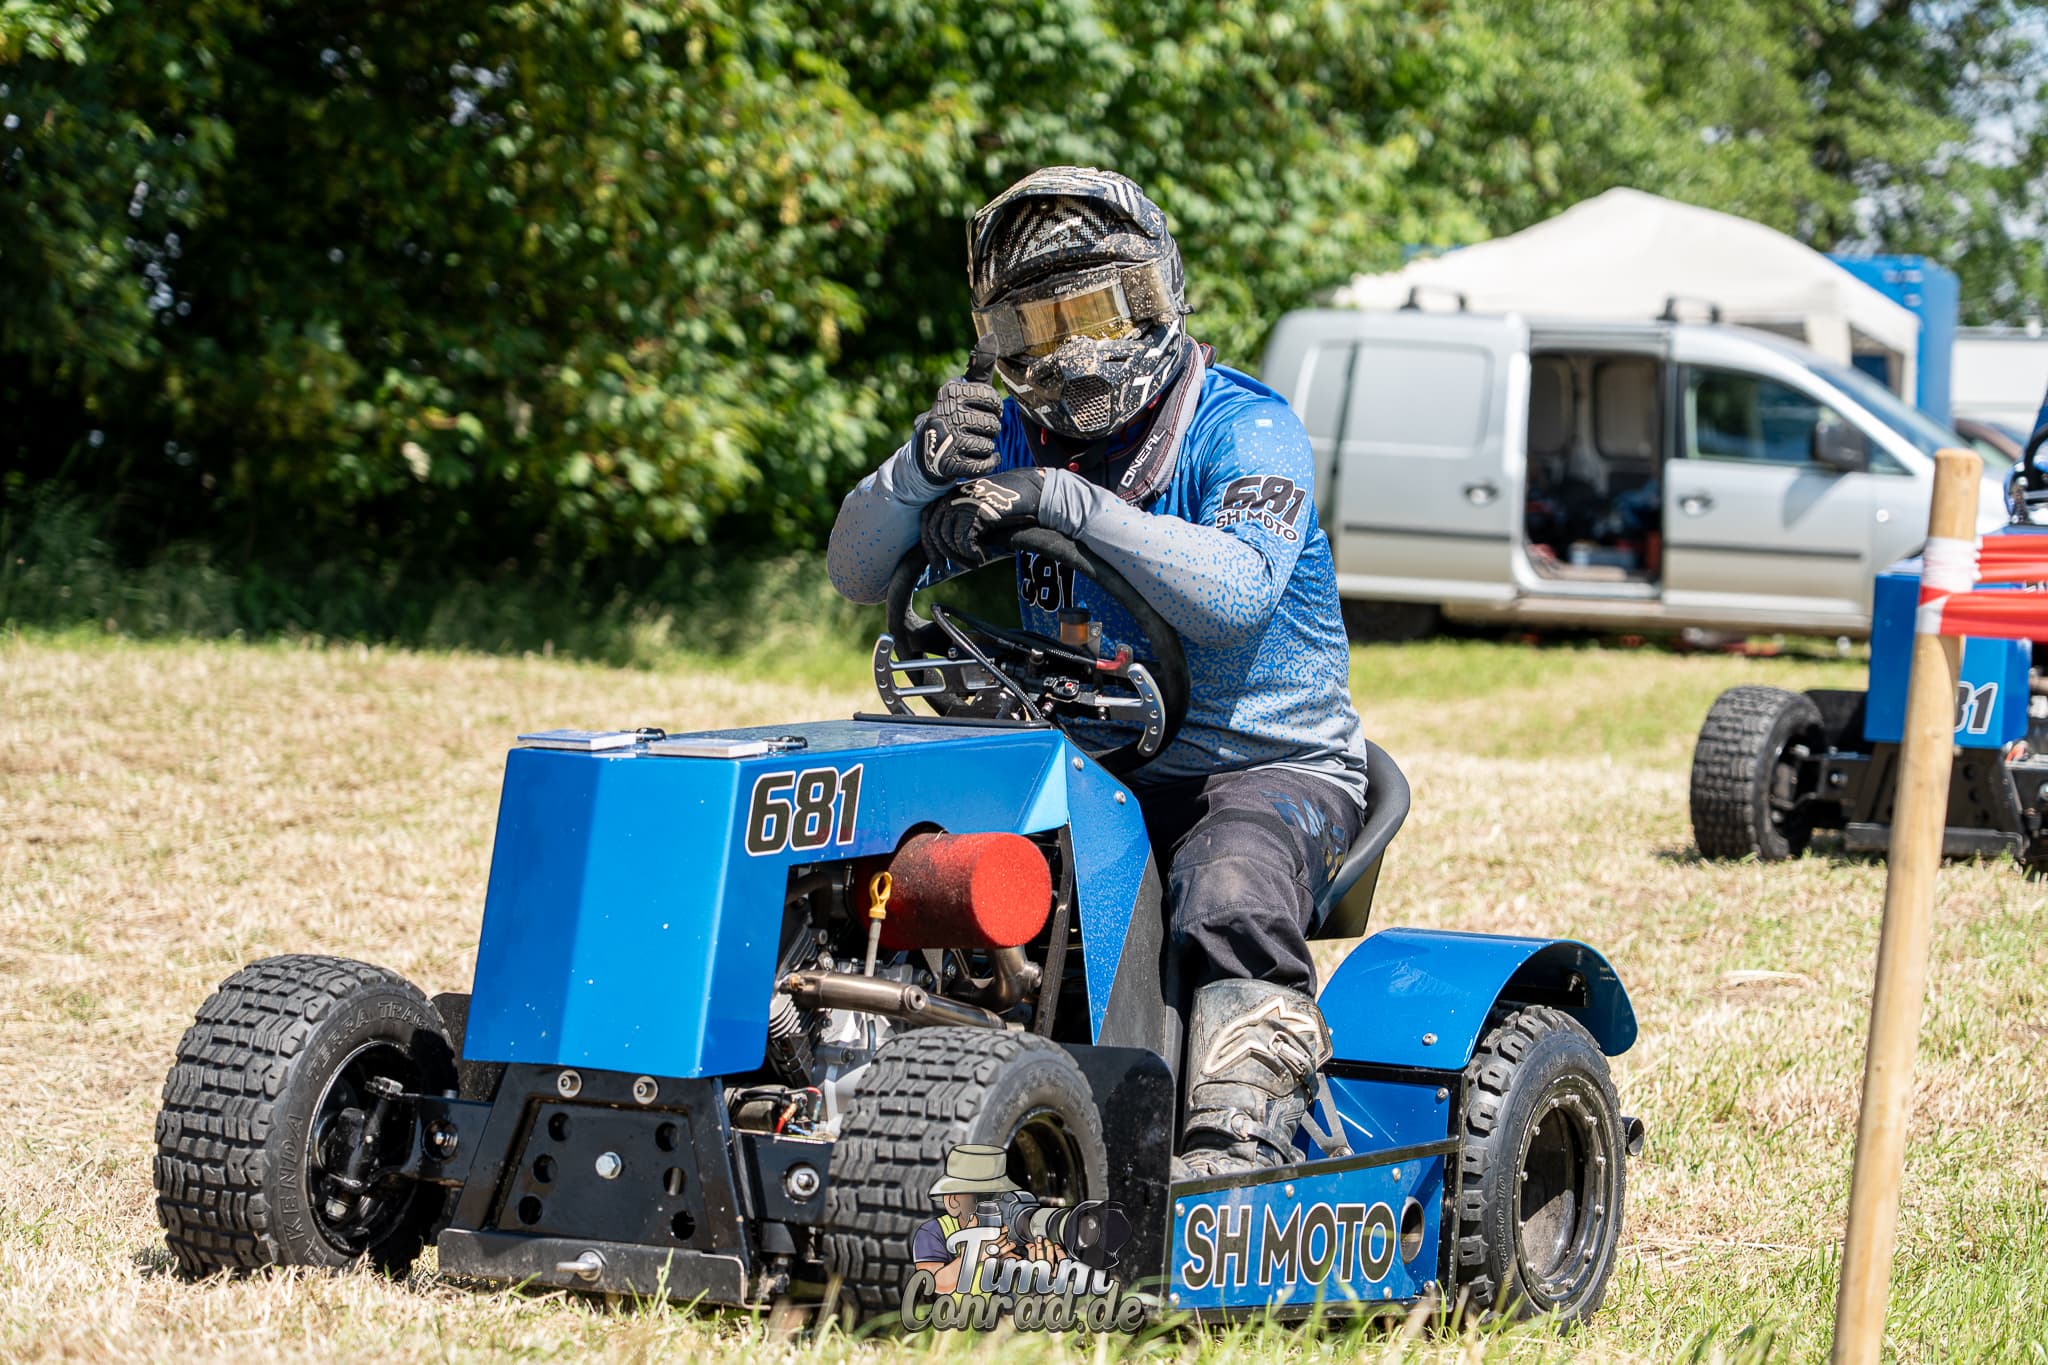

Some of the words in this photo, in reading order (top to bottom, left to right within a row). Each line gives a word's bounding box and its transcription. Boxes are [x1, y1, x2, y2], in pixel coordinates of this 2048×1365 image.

[1215, 511, 1240, 529] SH
[1246, 511, 1298, 541] MOTO
[1222, 475, 1306, 527] 681
[745, 763, 864, 857] 681
[306, 1008, 369, 1081] TERRA
[279, 1114, 305, 1240] KENDA
[1182, 1204, 1252, 1290] SH
[1258, 1202, 1396, 1286] MOTO
